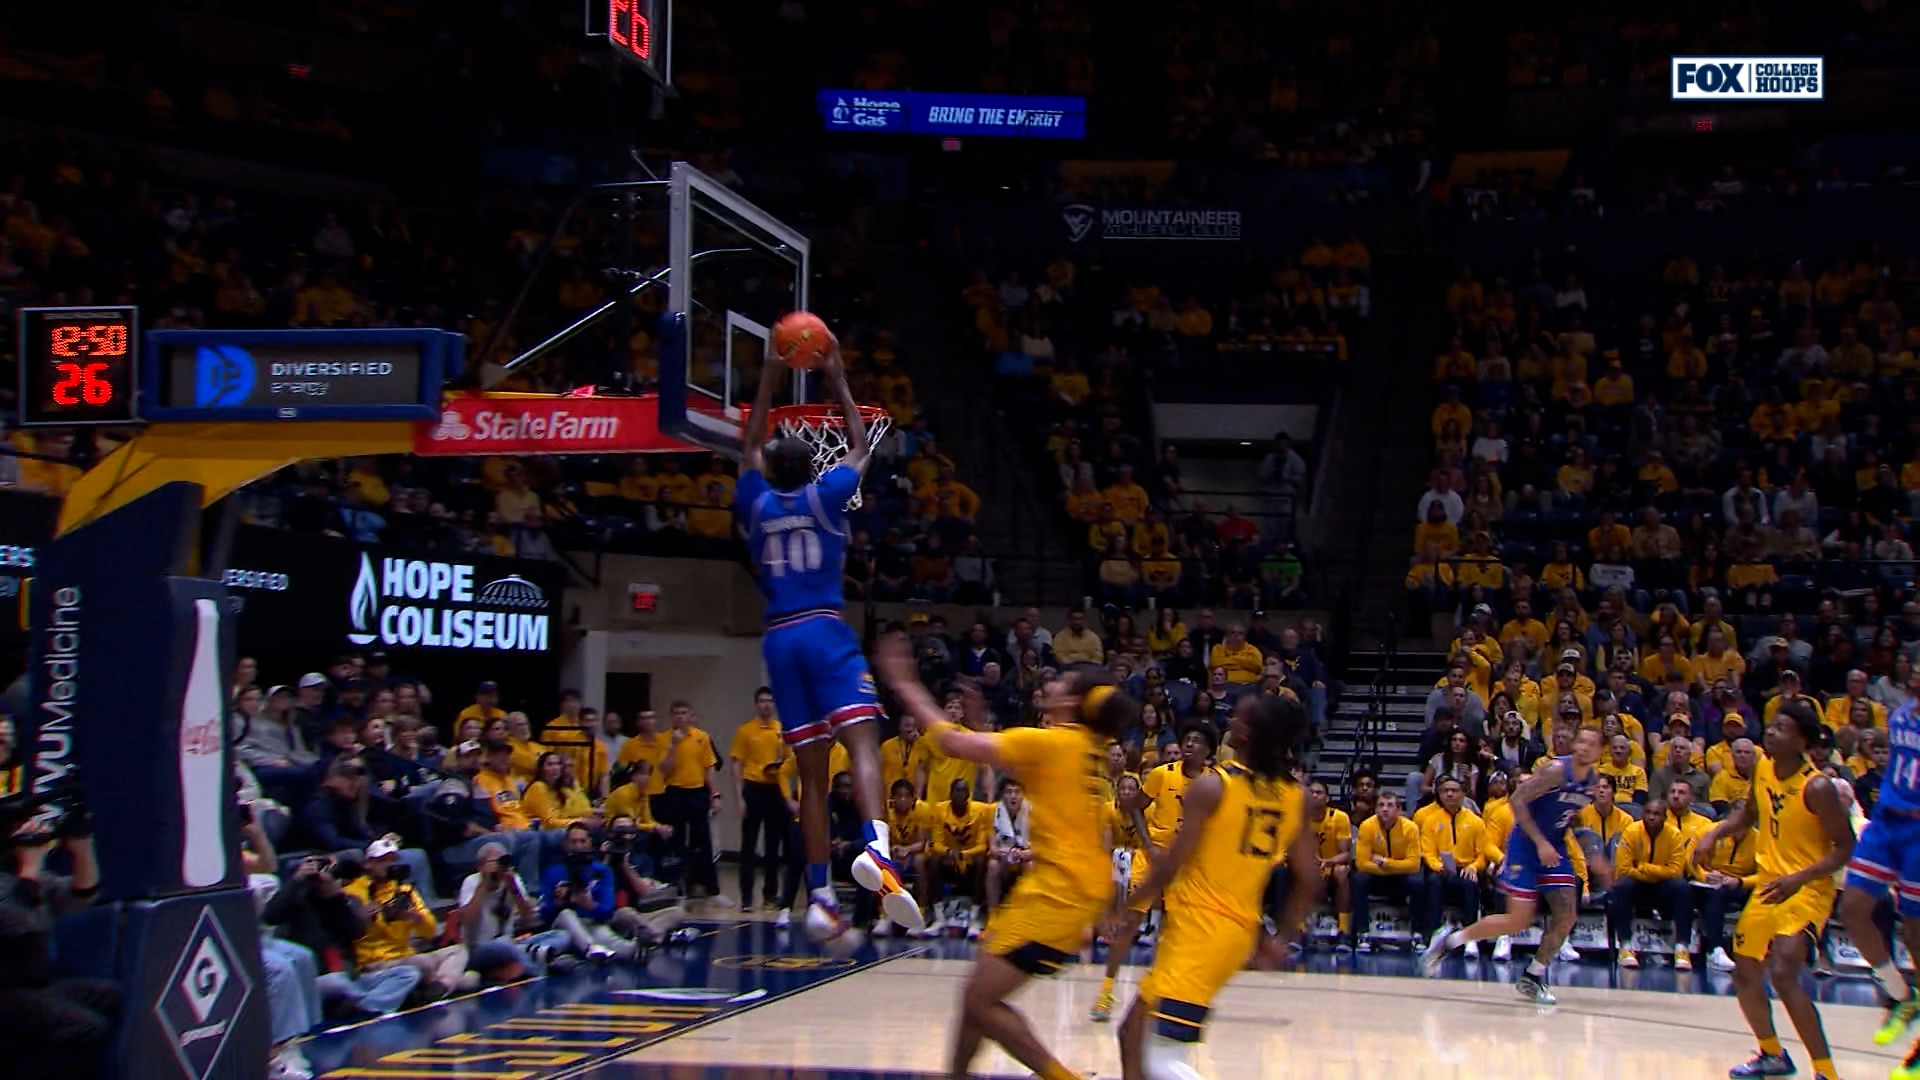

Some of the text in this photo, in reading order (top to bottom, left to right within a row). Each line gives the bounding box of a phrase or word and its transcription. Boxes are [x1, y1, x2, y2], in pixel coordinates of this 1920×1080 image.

[853, 113, 887, 127] Gas
[928, 106, 974, 124] BRING
[978, 108, 1004, 125] THE
[1102, 208, 1241, 225] MOUNTAINEER
[53, 362, 112, 405] 26
[271, 362, 393, 376] DIVERSIFIED
[761, 529, 823, 576] 40
[382, 557, 475, 602] HOPE
[380, 604, 549, 650] COLISEUM
